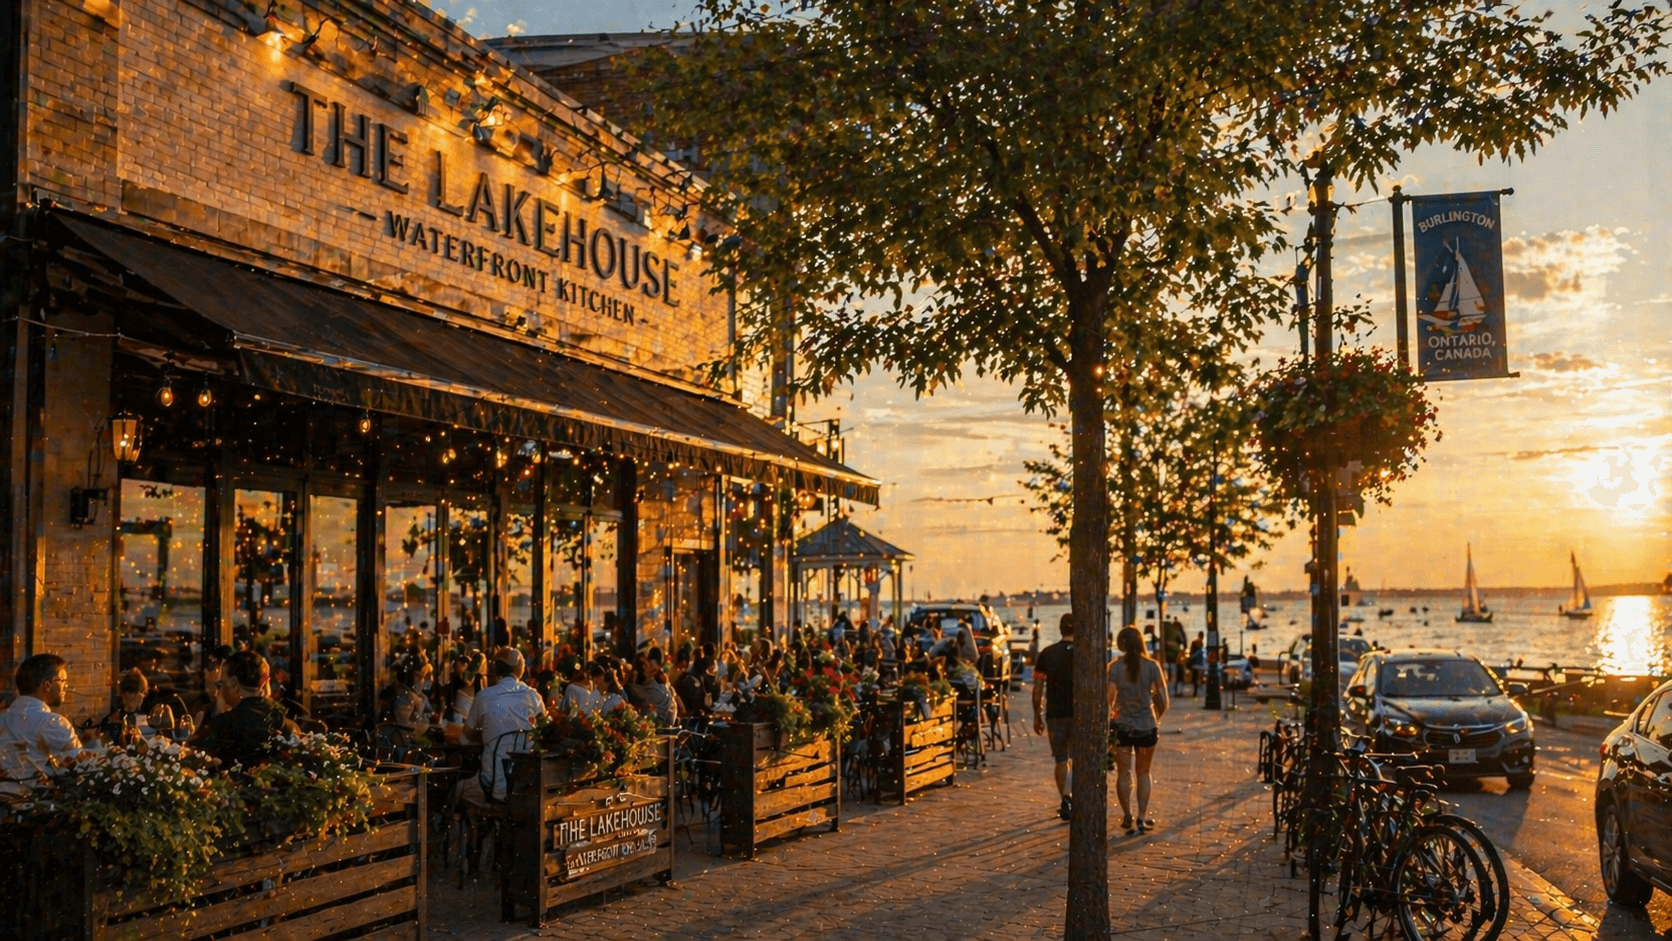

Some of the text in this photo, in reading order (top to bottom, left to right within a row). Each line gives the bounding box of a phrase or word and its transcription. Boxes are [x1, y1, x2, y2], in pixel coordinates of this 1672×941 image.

[291, 81, 680, 307] THE LAKEHOUSE
[1418, 211, 1496, 233] BURLINGTON
[386, 211, 635, 326] WATERFRONT KITCHEN
[1428, 332, 1496, 348] ONTARIO,
[1434, 347, 1492, 361] CANADA
